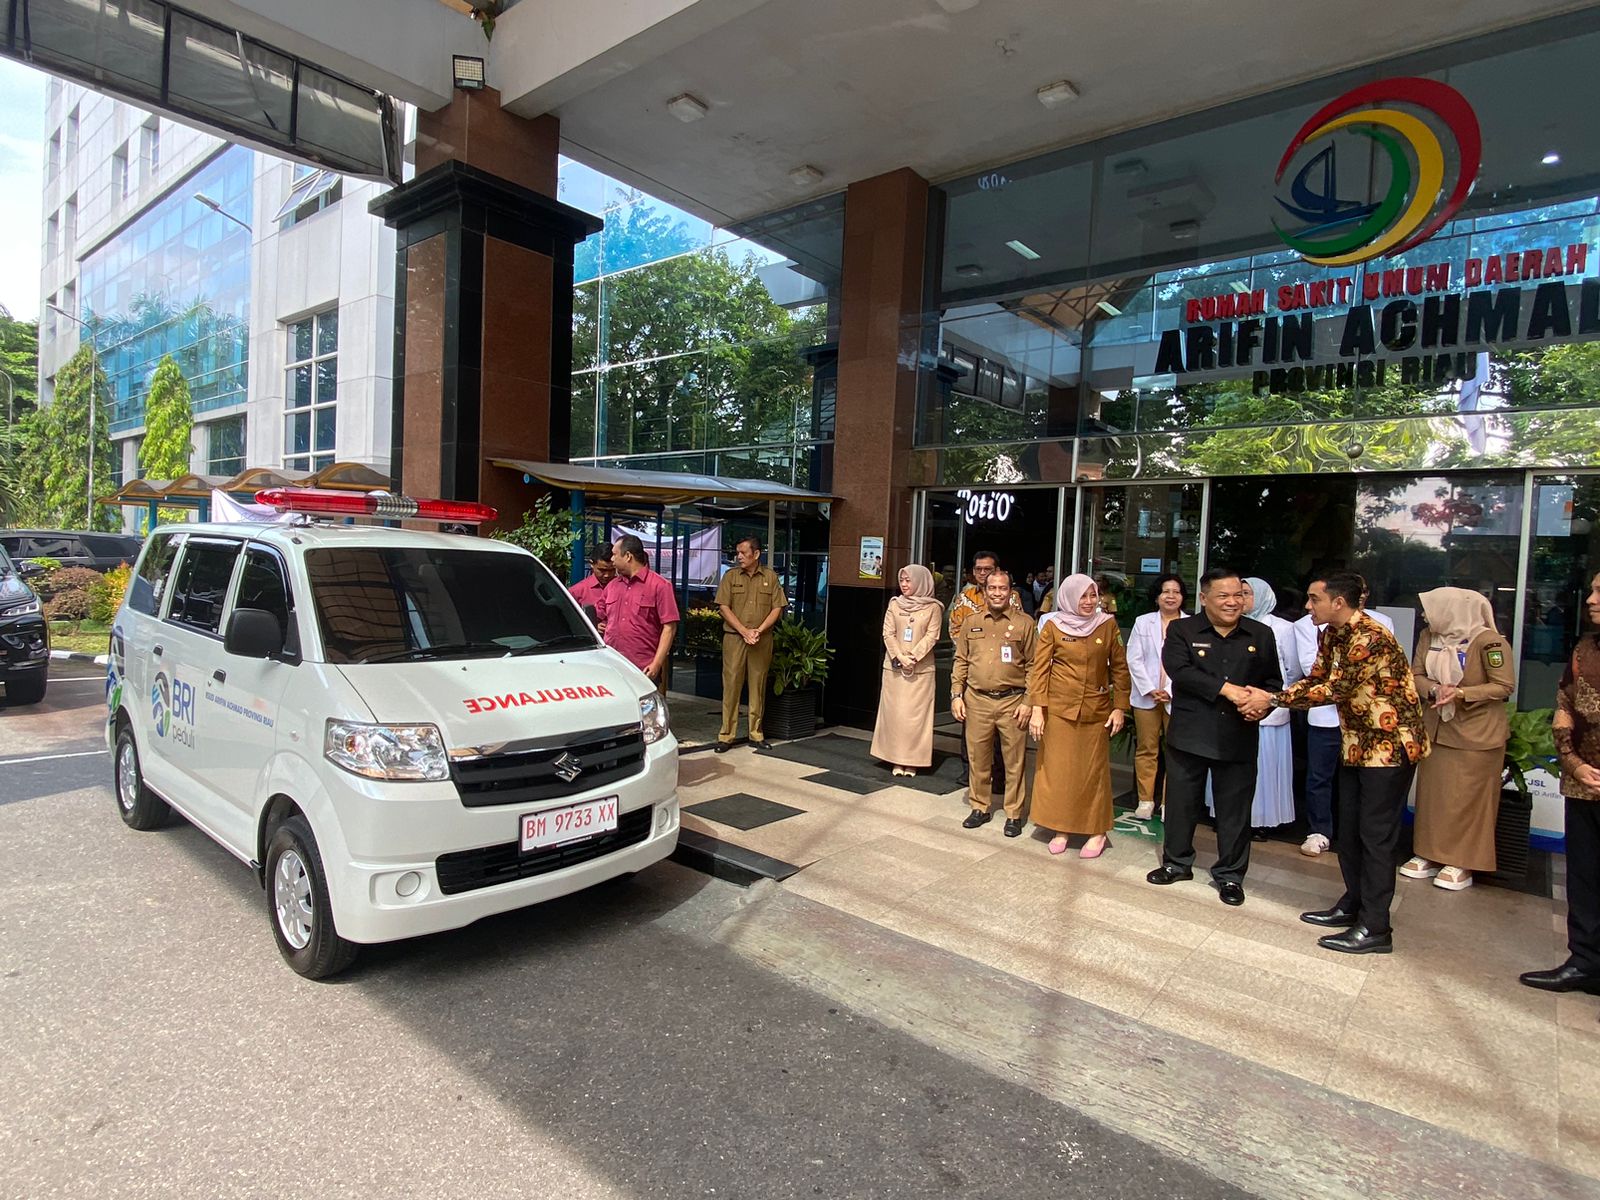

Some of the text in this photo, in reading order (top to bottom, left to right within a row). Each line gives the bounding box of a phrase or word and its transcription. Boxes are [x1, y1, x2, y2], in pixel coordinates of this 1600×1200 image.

[1186, 243, 1588, 324] RUMAH SAKIT UMUM DAERAH
[1155, 312, 1315, 375] ARIFIN
[1253, 351, 1477, 395] PROVINSI RIAU
[172, 678, 196, 726] BRI
[226, 700, 244, 715] ACHMAD
[243, 706, 263, 723] PROVINSI
[262, 716, 274, 729] RIAU
[172, 724, 196, 750] peduli
[1524, 778, 1547, 788] JSL
[526, 801, 616, 839] BM 9733 XX
